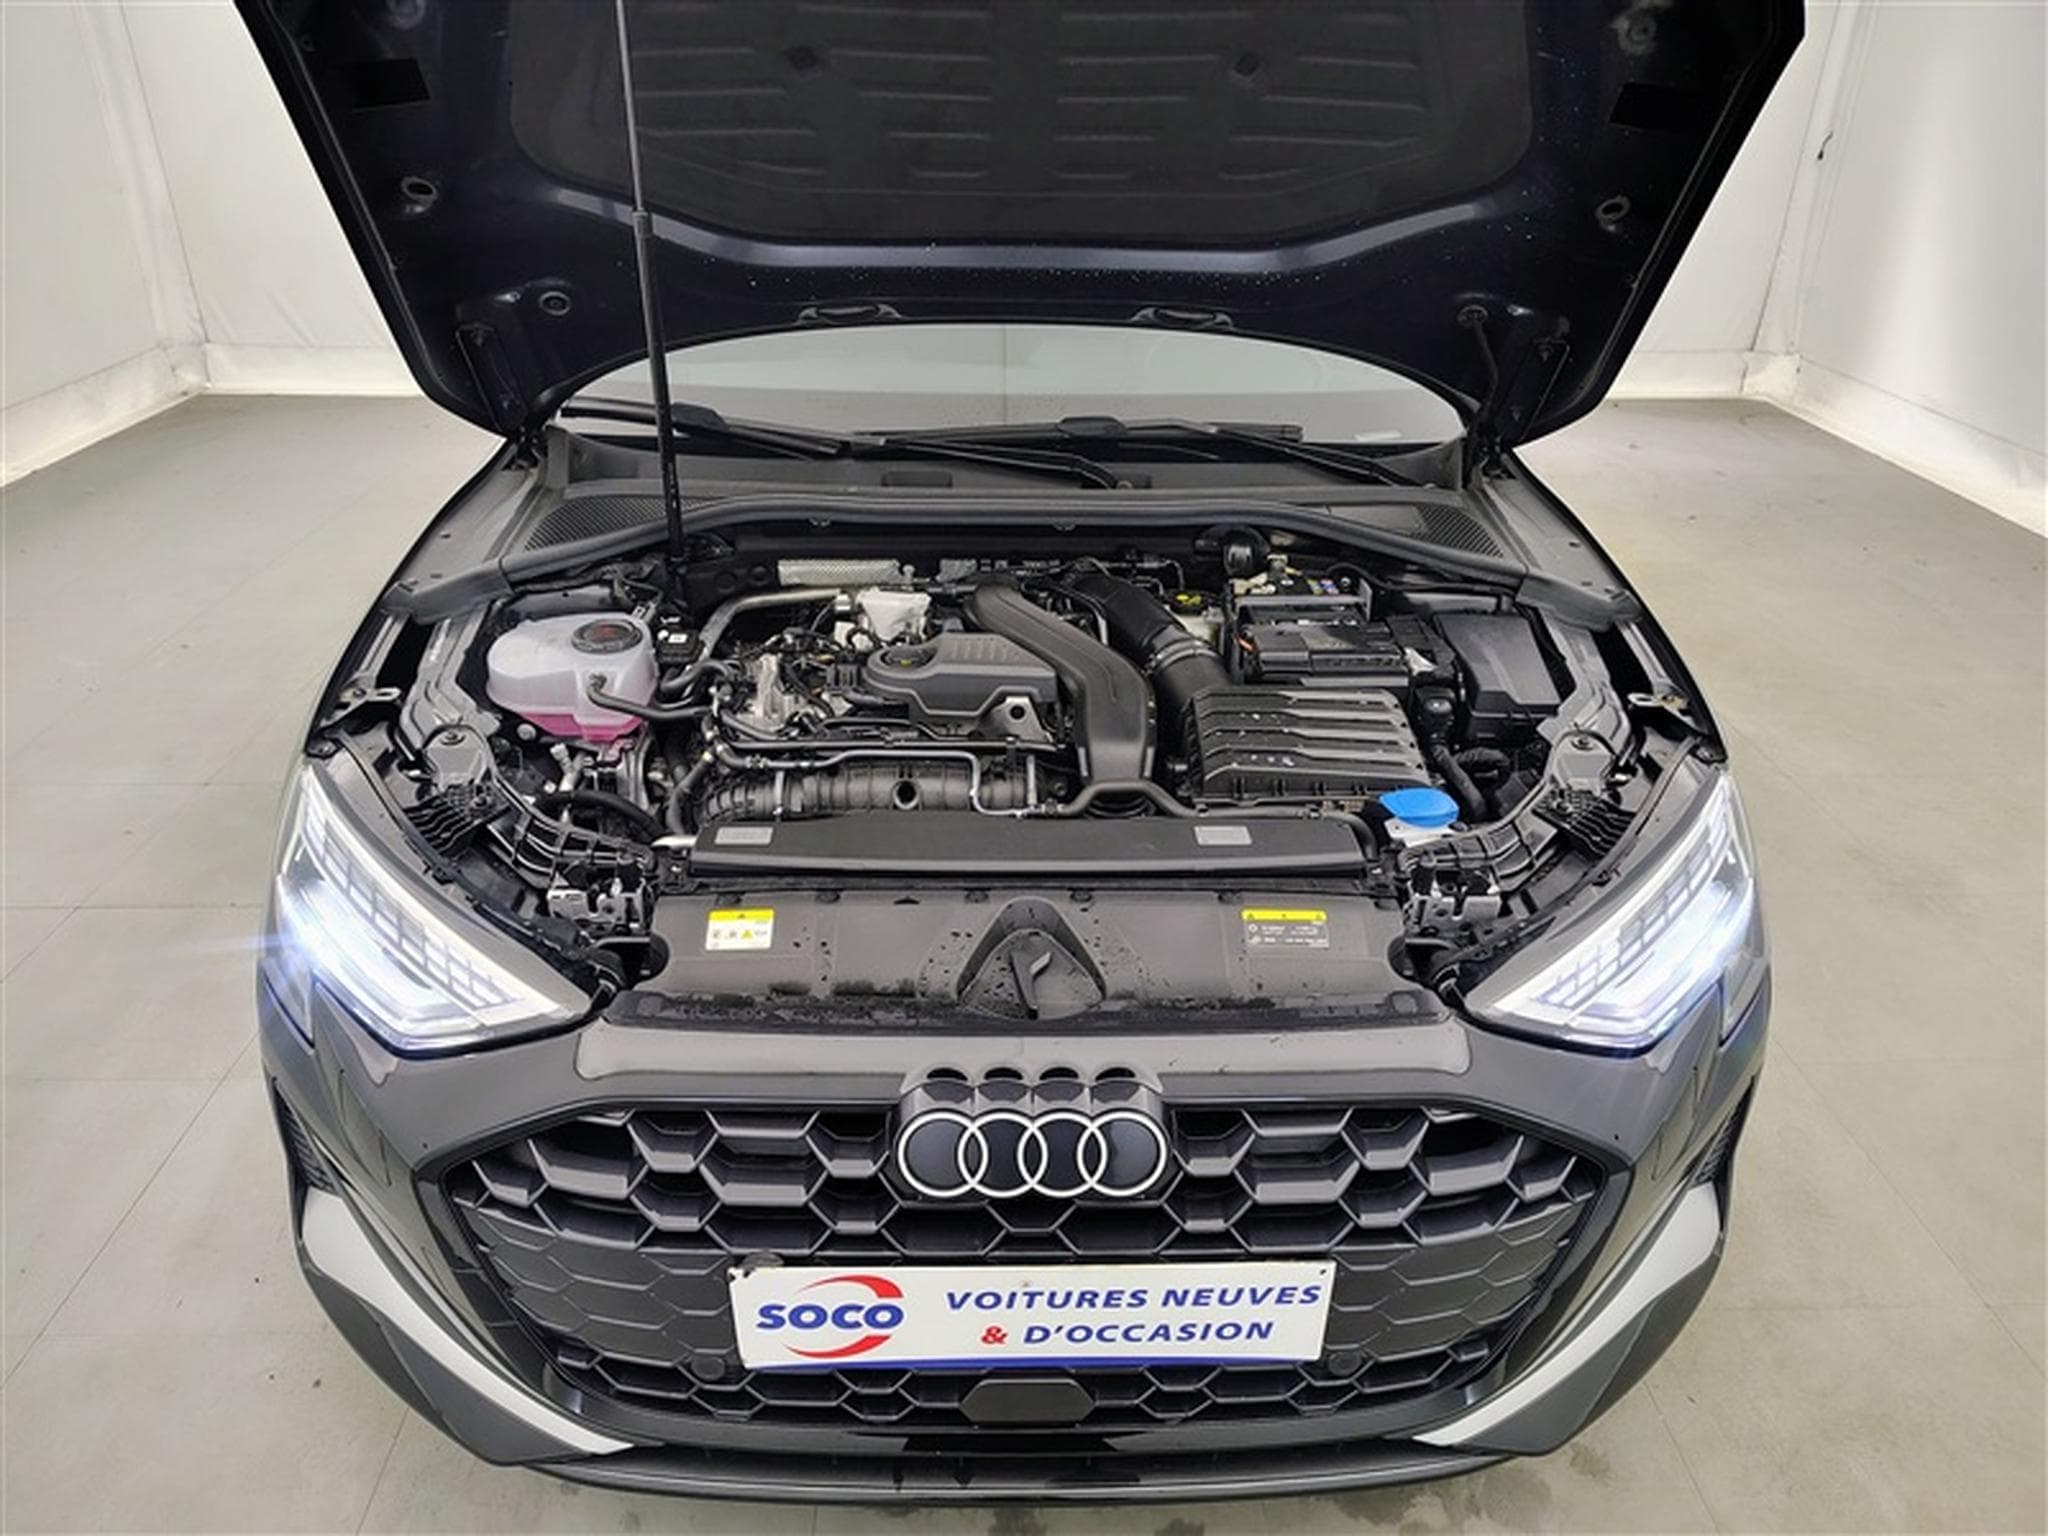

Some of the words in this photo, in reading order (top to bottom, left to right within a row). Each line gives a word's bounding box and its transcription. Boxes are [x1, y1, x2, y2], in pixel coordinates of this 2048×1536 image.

[946, 1290, 1148, 1310] VOITURES
[1162, 1286, 1322, 1306] NEUVES
[757, 1304, 904, 1329] SOCO
[981, 1326, 1007, 1345] &
[1023, 1322, 1274, 1345] D'OCCASION
